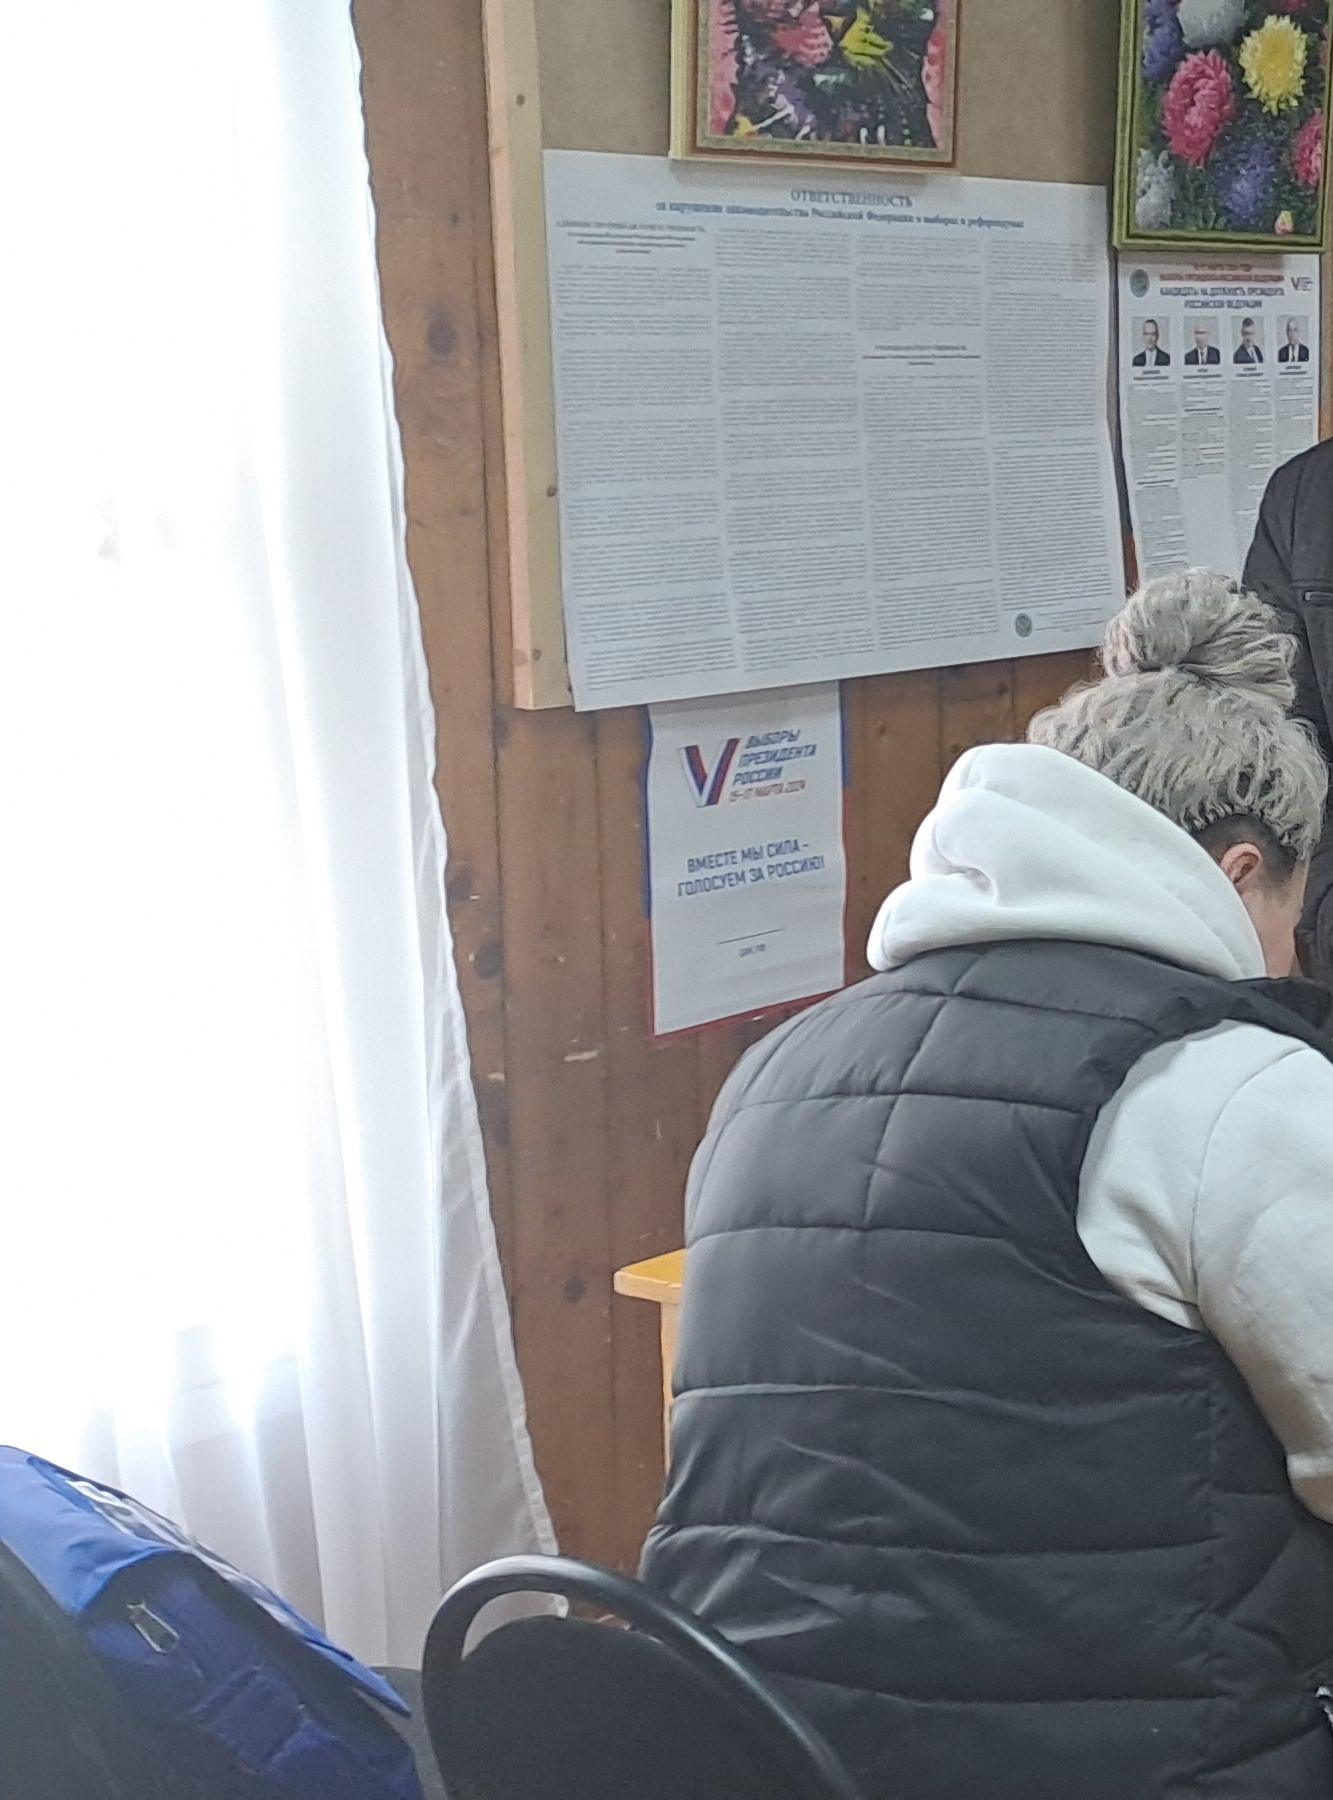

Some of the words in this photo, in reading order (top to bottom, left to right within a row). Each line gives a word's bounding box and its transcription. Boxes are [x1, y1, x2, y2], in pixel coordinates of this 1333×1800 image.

[790, 189, 913, 208] ОТВЕТСТВЕННОСТЬ
[745, 728, 801, 749] ВЫБОРЫ
[737, 744, 817, 768] ПРЕЗИДЕНТА
[732, 766, 784, 788] РОССИИ
[686, 850, 739, 874] ВМЕСТЕ
[740, 845, 764, 863] МЫ
[766, 838, 801, 859] СИЛА
[676, 870, 747, 897] ГОЛОСУЕМ
[747, 867, 765, 883] ЗА
[765, 854, 827, 880] РОССИЮ!
